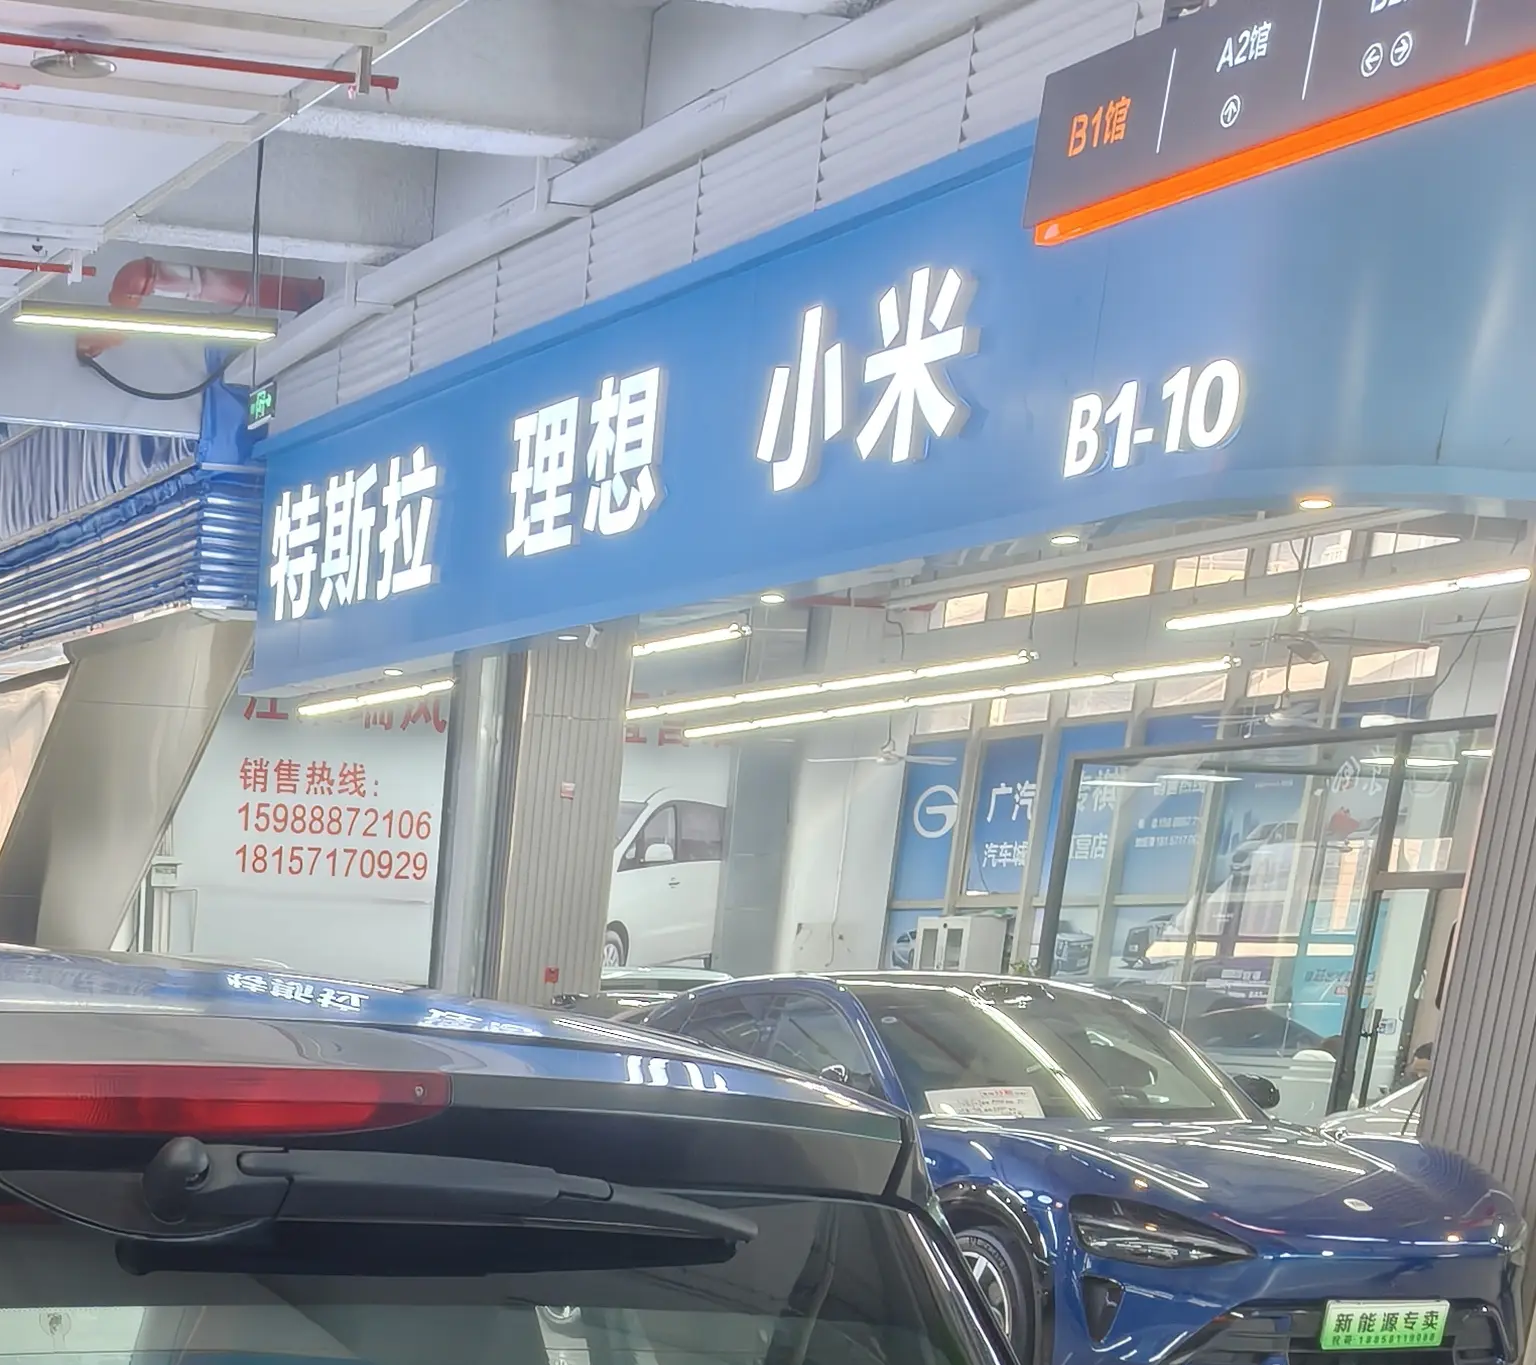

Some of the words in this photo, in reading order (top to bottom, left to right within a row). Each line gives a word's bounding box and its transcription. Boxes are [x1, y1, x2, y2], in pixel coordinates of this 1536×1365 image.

[1216, 21, 1272, 72] A2馆
[1068, 95, 1132, 157] B1馆
[269, 446, 443, 622] 特斯拉
[505, 367, 667, 557] 理想
[756, 266, 976, 490] 小米
[1062, 357, 1242, 479] B1-10
[237, 802, 432, 840] 15988872106
[235, 844, 429, 881] 18157170929
[1333, 1311, 1439, 1333] 新能源专卖
